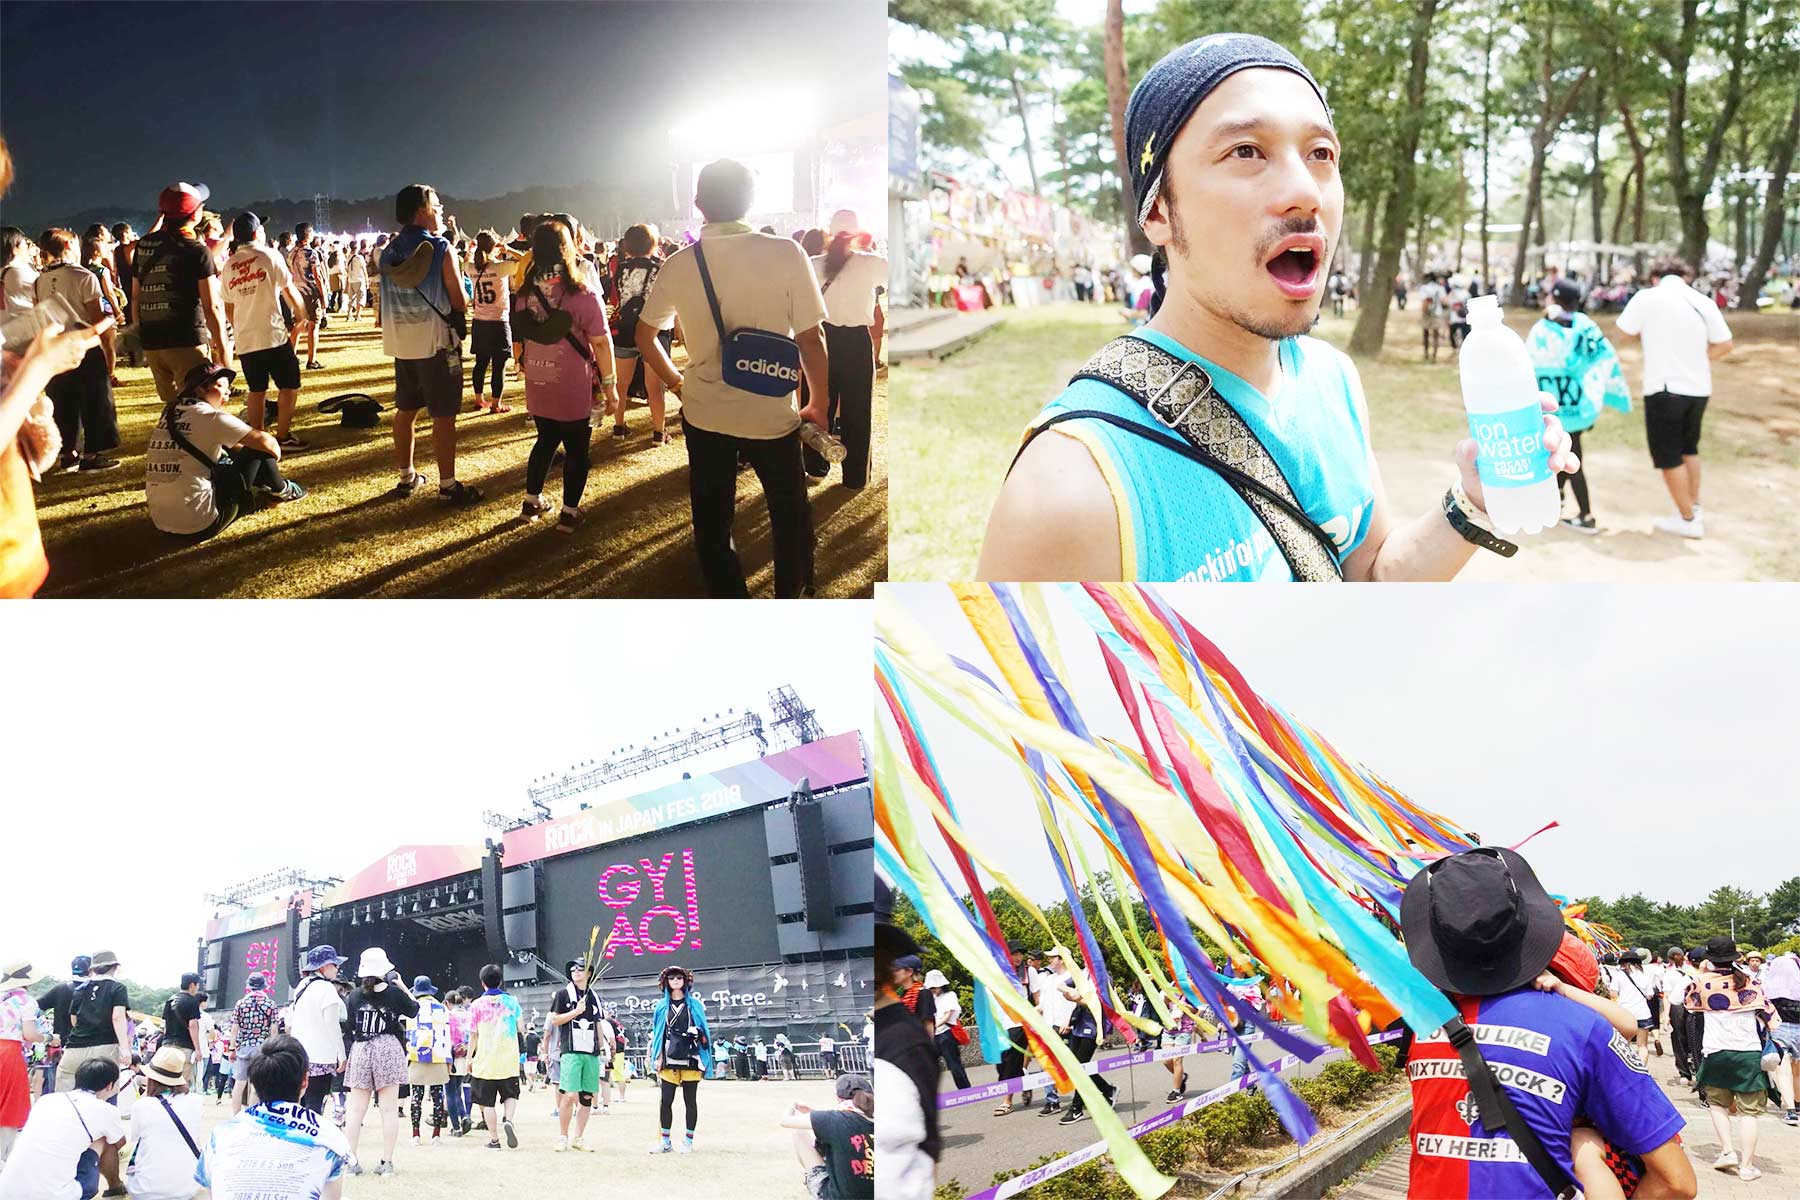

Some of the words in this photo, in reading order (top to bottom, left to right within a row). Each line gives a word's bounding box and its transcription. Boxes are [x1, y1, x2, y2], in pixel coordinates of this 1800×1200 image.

[477, 281, 496, 304] 15
[736, 358, 799, 382] adidas
[1473, 418, 1508, 441] ion
[1478, 432, 1542, 458] water
[545, 816, 594, 852] ROCK
[599, 819, 614, 839] IN
[616, 804, 664, 833] JAPAN
[667, 798, 699, 819] FES.
[701, 784, 742, 810] 2018
[387, 849, 417, 881] ROCK
[625, 995, 661, 1013] Pea
[711, 989, 773, 1011] Free.
[1495, 1028, 1547, 1052] LIKE
[1409, 1062, 1465, 1077] MIXTUR
[1418, 1137, 1443, 1153] FLY
[1450, 1140, 1498, 1158] HERE
